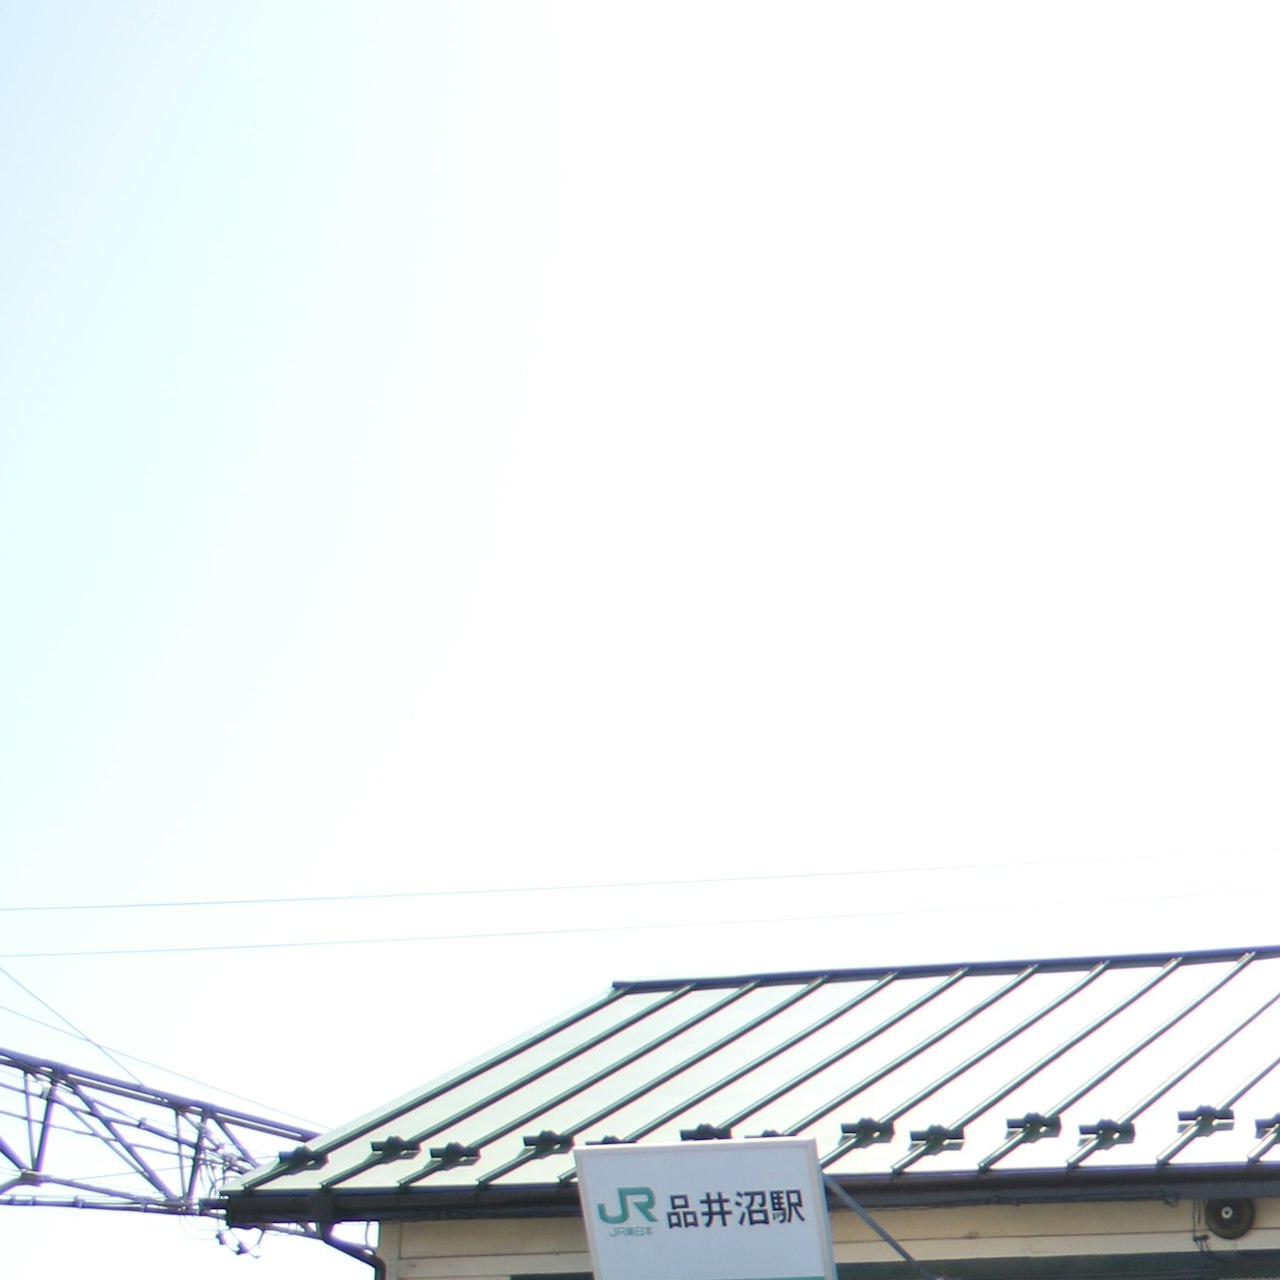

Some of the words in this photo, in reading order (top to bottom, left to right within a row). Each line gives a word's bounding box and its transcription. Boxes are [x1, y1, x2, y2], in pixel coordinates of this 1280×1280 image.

[597, 1186, 659, 1224] JR
[666, 1188, 807, 1229] 品井沼駅
[609, 1226, 654, 1237] JR東日本
